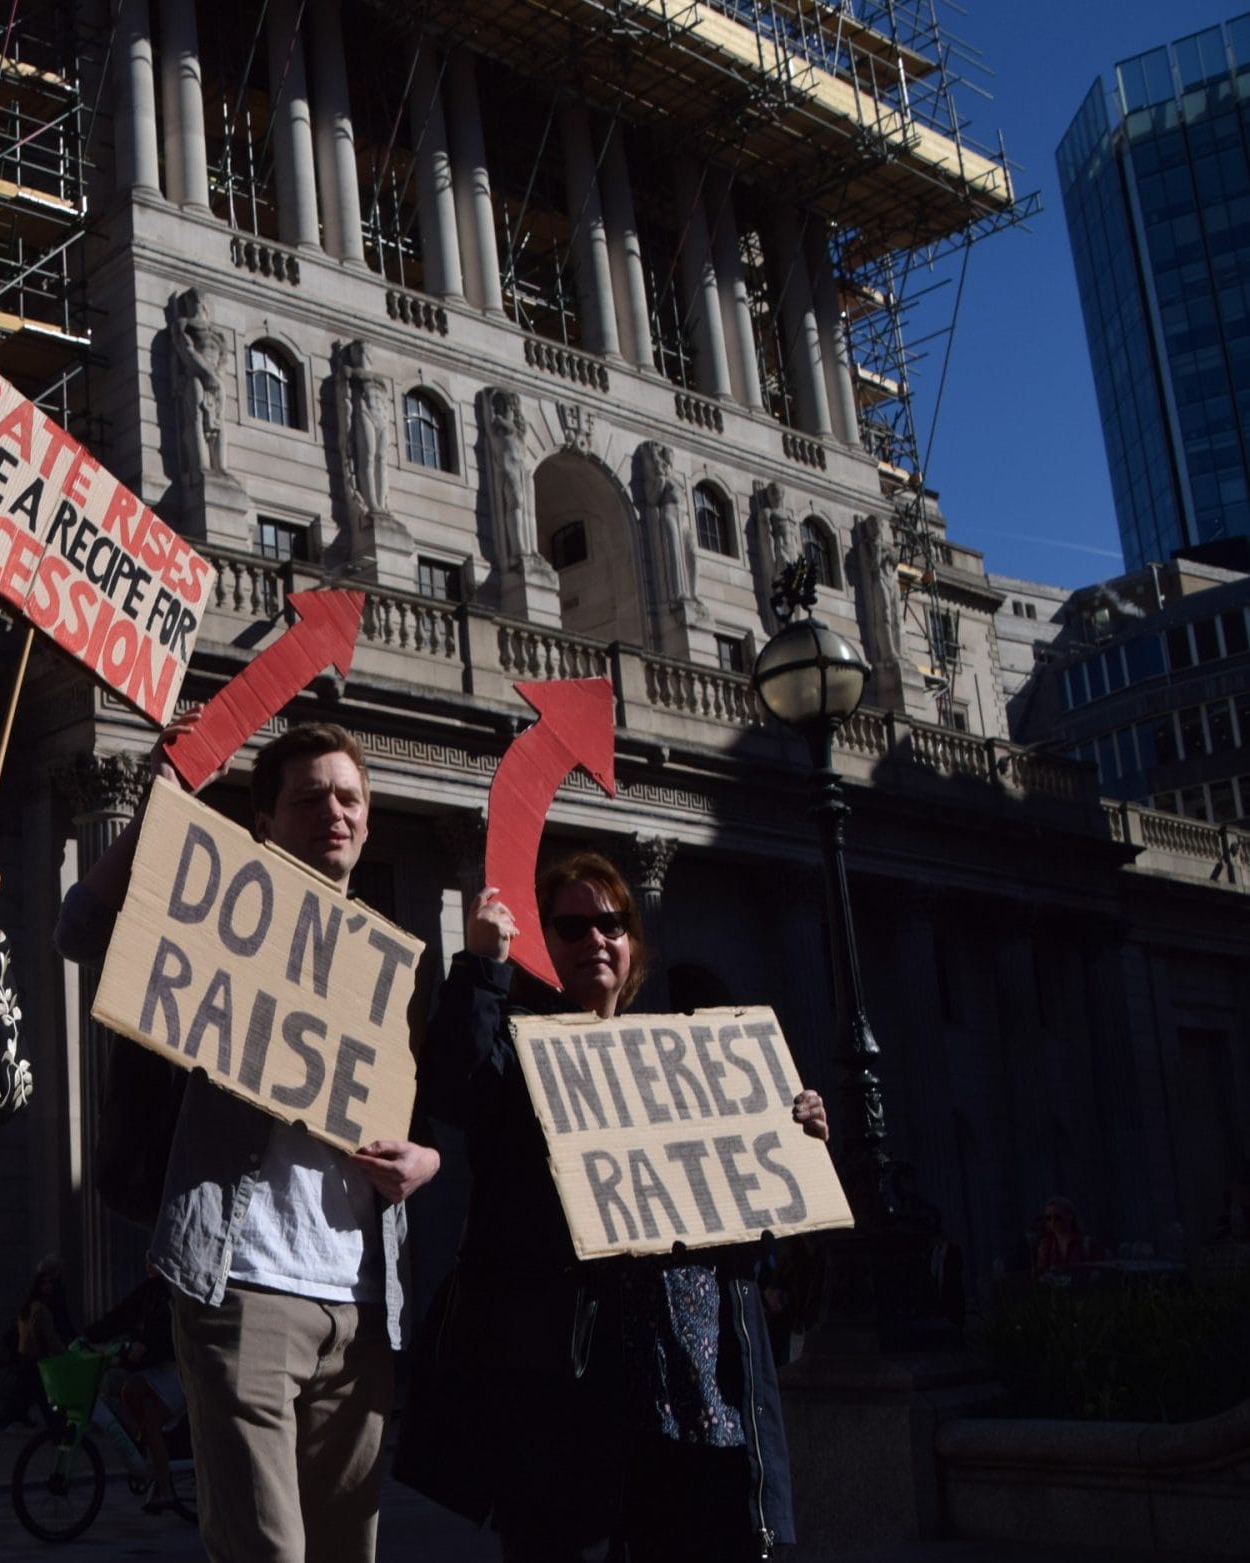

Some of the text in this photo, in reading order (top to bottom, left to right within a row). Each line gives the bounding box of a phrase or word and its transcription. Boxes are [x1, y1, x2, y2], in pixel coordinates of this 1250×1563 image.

[9, 478, 45, 533] A
[46, 499, 152, 619] RECIPE
[146, 587, 197, 662] FOR
[102, 481, 209, 604] RISES
[167, 822, 415, 1027] DON'T
[139, 935, 376, 1146] RAISE
[529, 1021, 795, 1134] INTEREST
[581, 1131, 808, 1244] RATES
